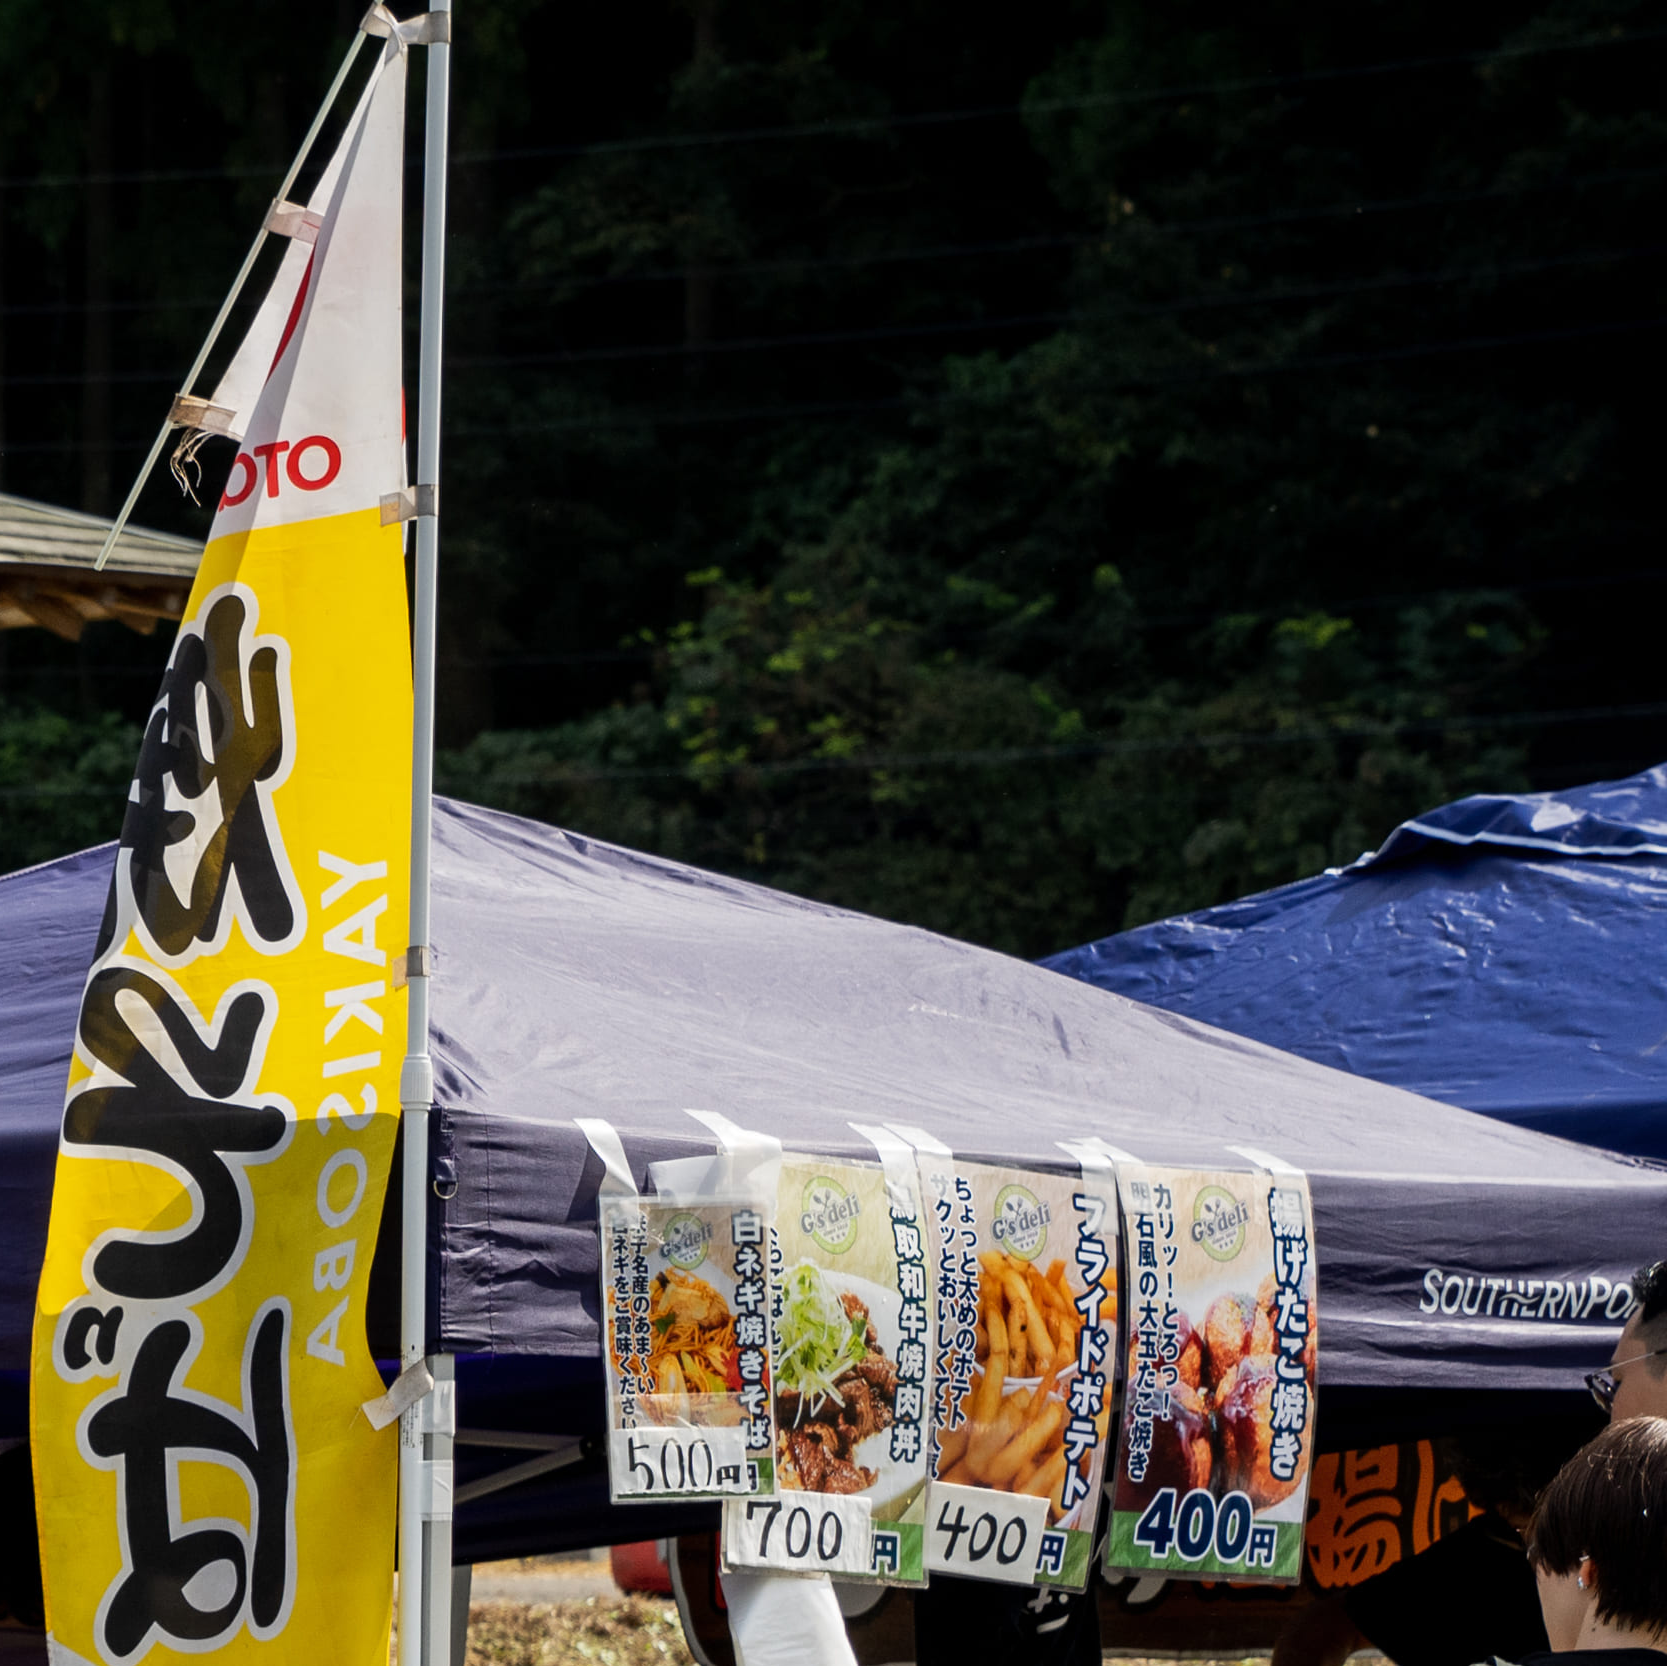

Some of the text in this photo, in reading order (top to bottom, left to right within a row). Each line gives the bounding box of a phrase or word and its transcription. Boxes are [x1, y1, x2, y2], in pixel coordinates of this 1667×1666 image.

[827, 1193, 860, 1222] deli
[992, 1217, 1016, 1240] G's
[1018, 1203, 1051, 1232] deli
[1191, 1221, 1215, 1243] G's
[1217, 1202, 1249, 1232] deli
[730, 1208, 772, 1450] 白ネギ焼きそば
[950, 1177, 979, 1432] ちょっと太めのポテト
[1063, 1193, 1110, 1508] フライドポテト
[1154, 1183, 1179, 1419] カリッ！とろっ！
[1134, 1489, 1277, 1567] 400円
